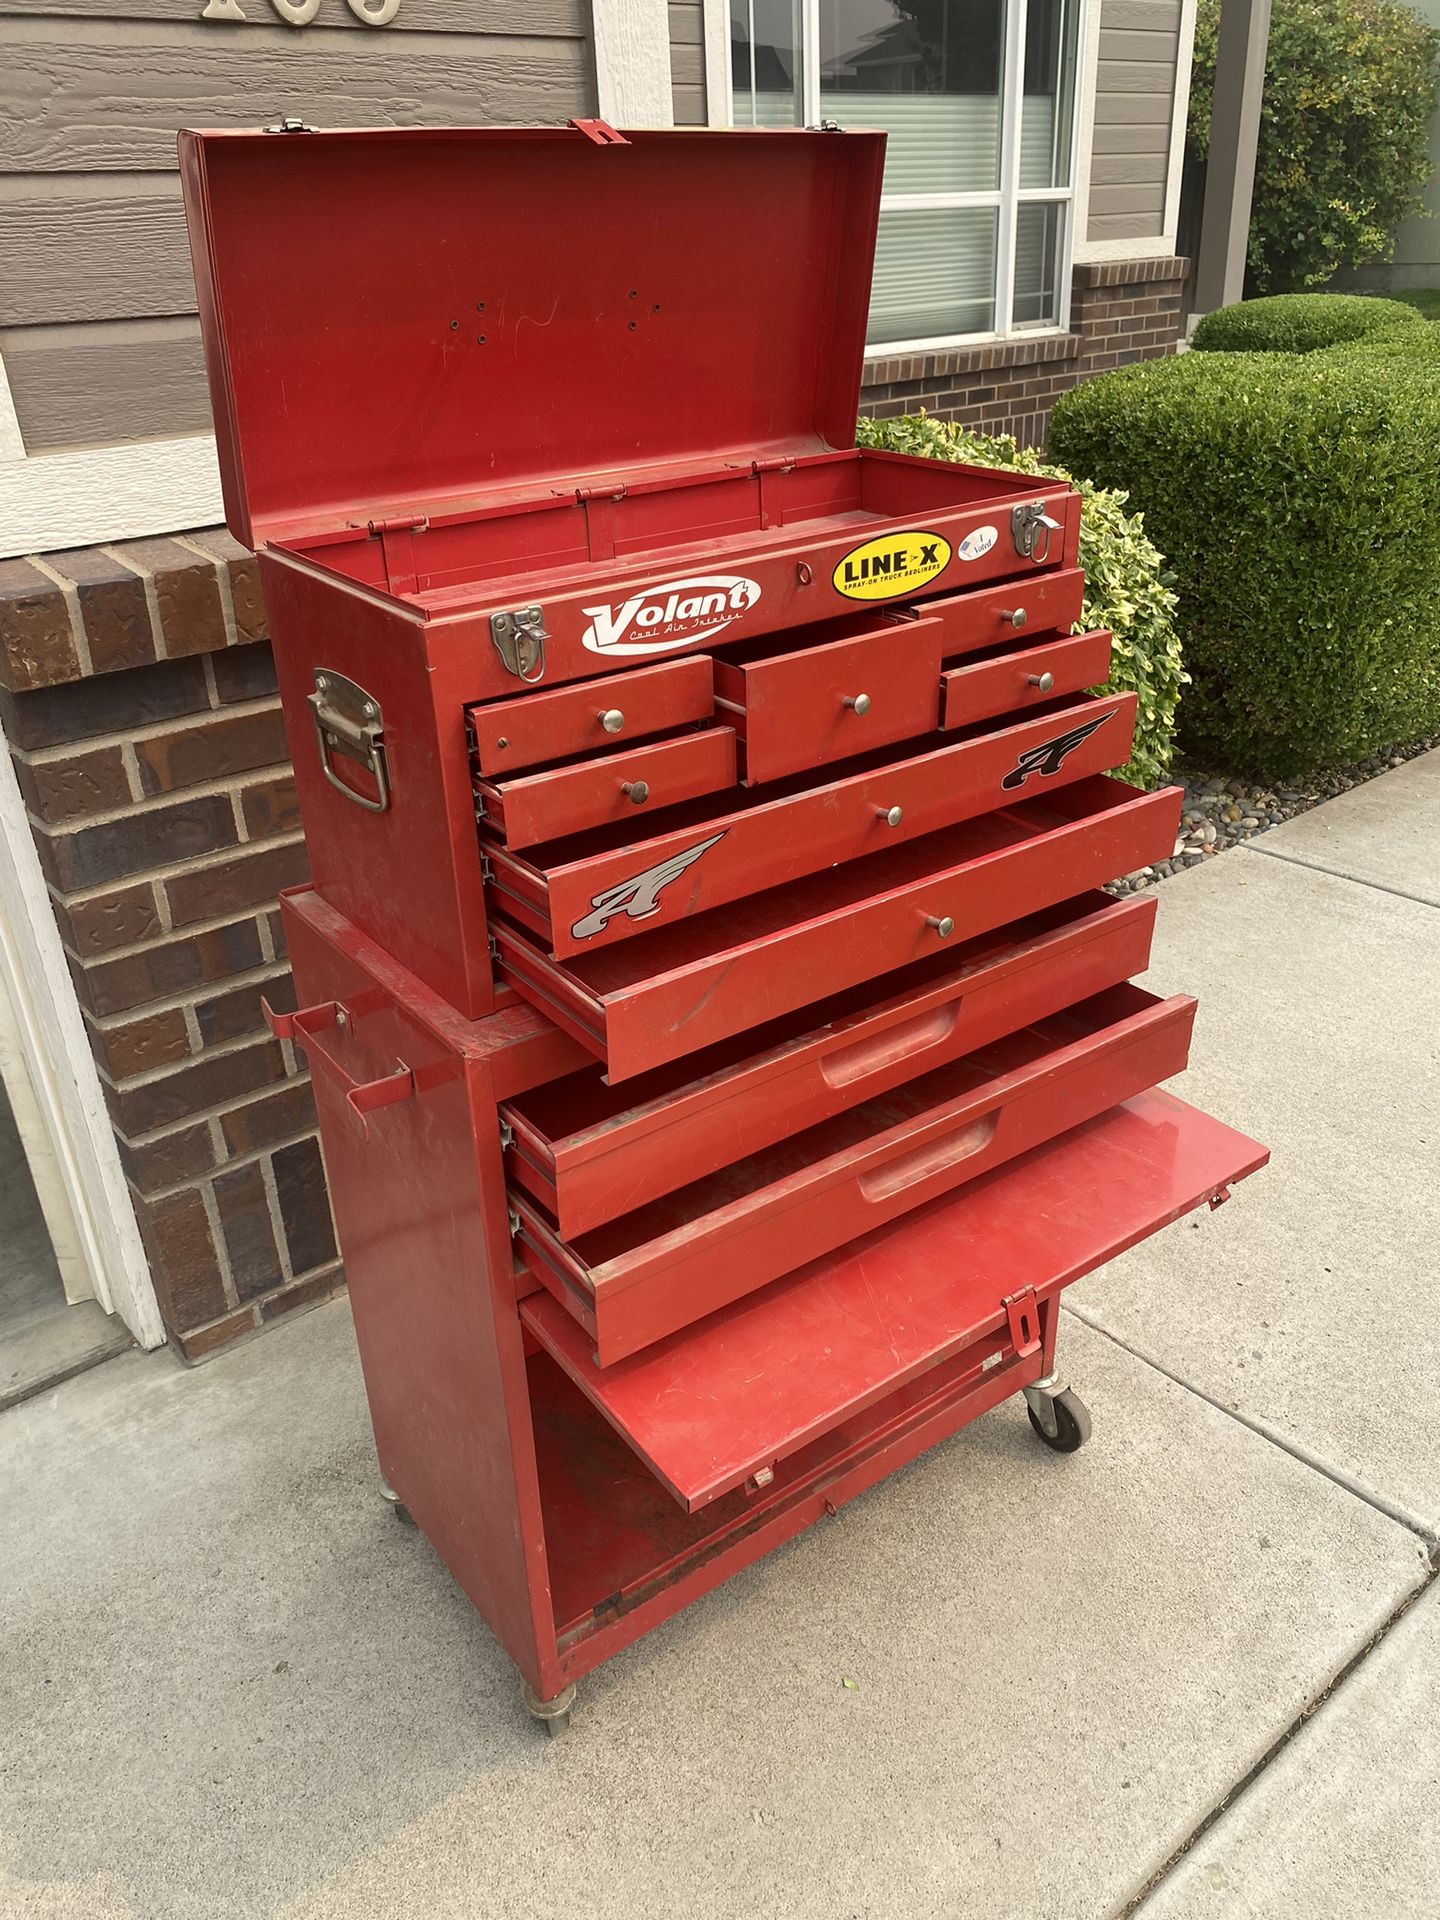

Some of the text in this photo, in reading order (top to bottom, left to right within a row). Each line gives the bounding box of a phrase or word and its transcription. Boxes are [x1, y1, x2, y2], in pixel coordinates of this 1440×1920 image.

[843, 563, 941, 591] SPRAY-ON TRUCK BEDLINERS
[581, 580, 749, 647] Volant
[629, 612, 743, 641] Cool Air Intakes
